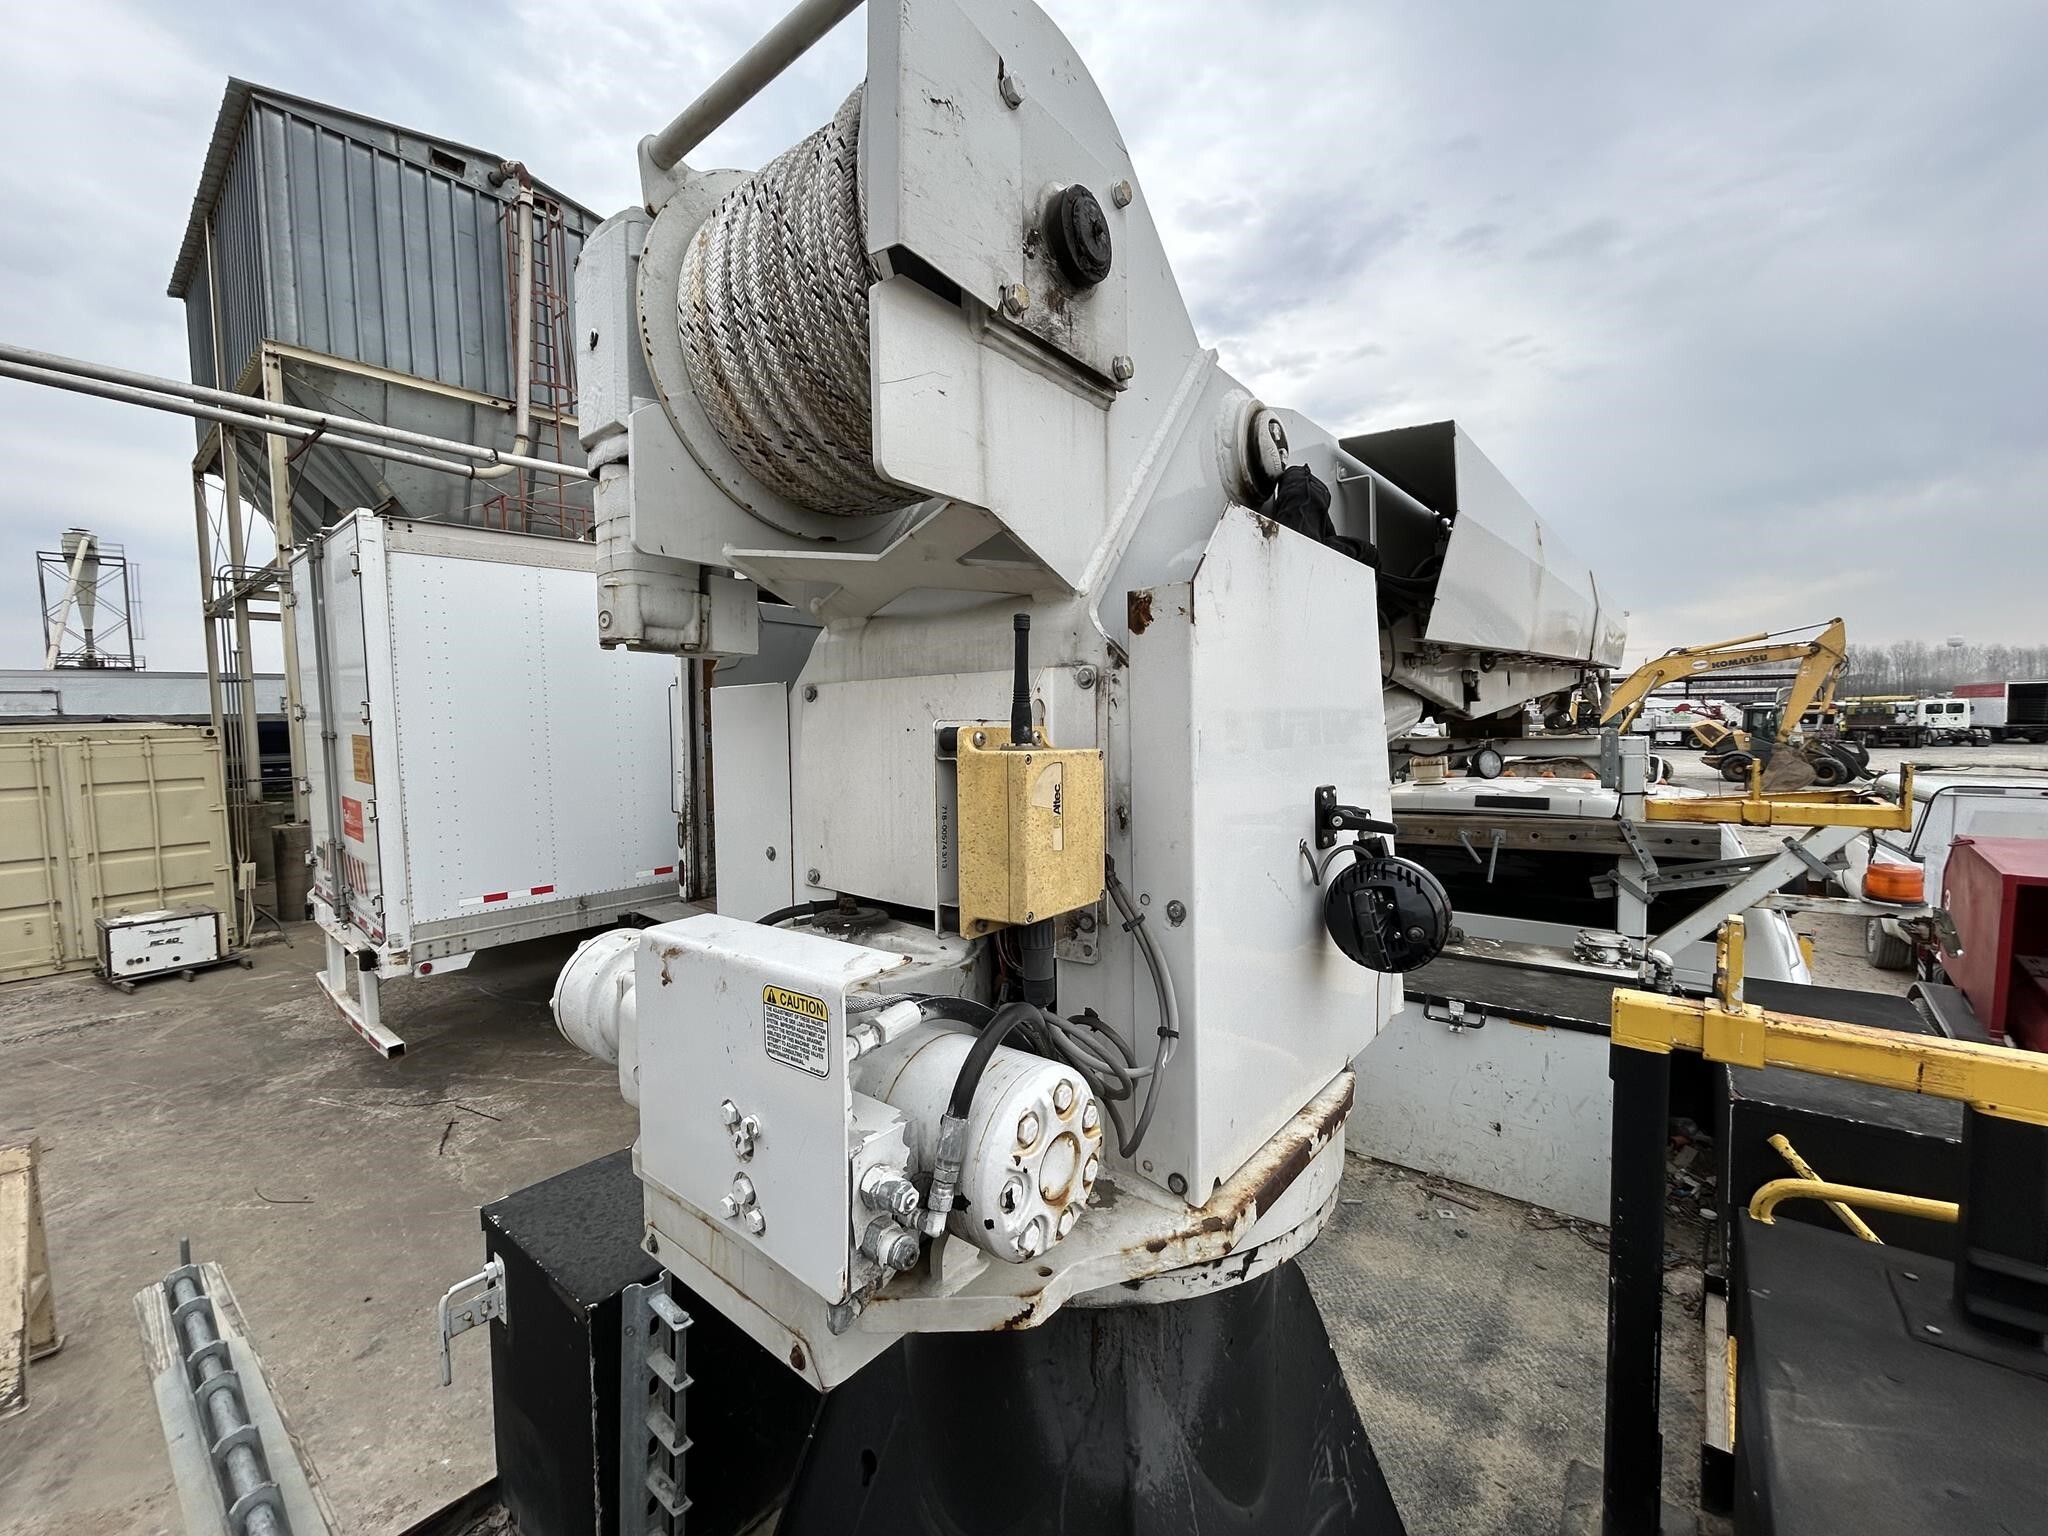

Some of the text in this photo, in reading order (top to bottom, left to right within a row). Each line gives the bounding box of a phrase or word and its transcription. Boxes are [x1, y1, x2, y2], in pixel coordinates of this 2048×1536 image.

[1711, 654, 1768, 669] KOMATSU
[1053, 783, 1061, 815] Altec
[1944, 889, 1951, 911] 3
[780, 993, 823, 1017] CAUTION
